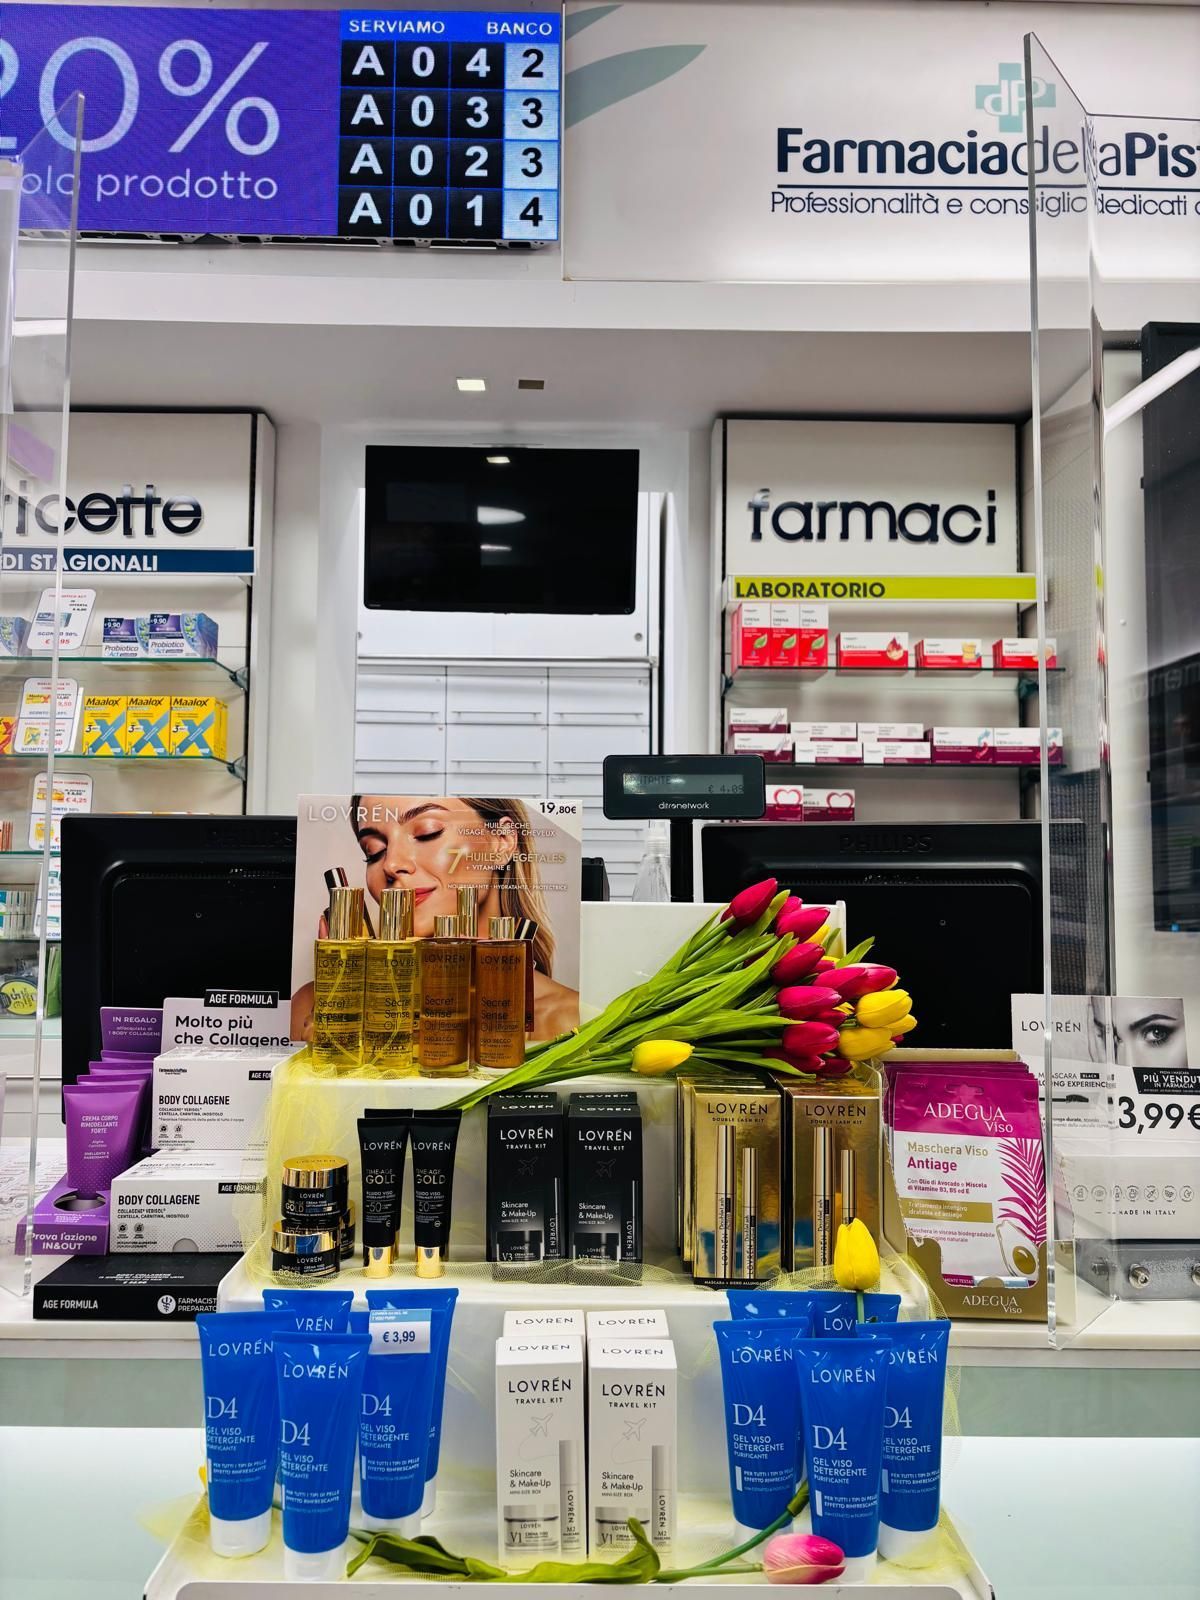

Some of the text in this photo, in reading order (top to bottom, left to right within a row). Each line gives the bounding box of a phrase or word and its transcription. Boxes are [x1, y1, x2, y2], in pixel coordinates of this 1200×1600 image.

[349, 19, 553, 37] SERVIAMO BANCO
[351, 45, 545, 79] A 0 4 2
[350, 93, 545, 130] A 0 3 3
[777, 126, 1200, 178] FarmaciadelaPis
[350, 143, 545, 179] A 0 2 3
[21, 165, 279, 200] olo prodotto
[349, 191, 544, 227] A 0 1 4
[771, 191, 939, 214] Professionalità
[946, 199, 963, 214] e
[969, 191, 1088, 217] consiglio
[2, 484, 202, 536] icette
[748, 488, 997, 544] farmaci
[0, 554, 158, 571] DI STAGIONALI
[735, 582, 886, 598] LABORATORIO
[86, 698, 121, 707] Maalox
[129, 698, 164, 707] Maalox
[172, 698, 209, 707] Maalox
[539, 802, 577, 816] 19,80€
[658, 801, 710, 809] ditronetwork
[308, 804, 399, 823] LOVRÉN
[447, 848, 465, 874] 7
[465, 852, 502, 863] HUILES
[472, 864, 504, 872] VITAMINE
[209, 993, 274, 1006] AGE FORMULA
[175, 1014, 254, 1031] Molto più
[174, 1032, 204, 1045] che
[1142, 1072, 1160, 1083] PIÙ
[158, 1095, 230, 1106] BODY COLLAGENE
[708, 1101, 769, 1115] LOVRÉN
[805, 1104, 867, 1117] LOVRÉN
[924, 1102, 1008, 1122] ADEGUA
[1118, 1095, 1200, 1135] 3,99€
[500, 1126, 554, 1140] LOVRÉN
[984, 1120, 1014, 1133] Viso
[578, 1128, 632, 1142] LOVRÉN
[364, 1141, 402, 1151] LOVRÉN
[413, 1141, 451, 1151] LOVRÉN
[907, 1142, 989, 1157] Maschera Viso
[907, 1156, 958, 1172] Antiage
[221, 1184, 233, 1192] AGE
[118, 1195, 200, 1206] BODY COLLAGENE
[501, 1201, 529, 1209] Skincare
[508, 1209, 537, 1218] Make-Up
[30, 1231, 98, 1242] Prova l'azione
[42, 1242, 83, 1250] IN&OUT
[42, 1300, 98, 1309] AGE FORMULA
[962, 1295, 1019, 1307] ADEGUA
[1003, 1305, 1023, 1314] Viso
[383, 1330, 416, 1345] € 3,99
[209, 1338, 274, 1357] LOVRÉN
[731, 1346, 793, 1364] LOVRÉN
[283, 1362, 349, 1379] LOVRÉN
[811, 1367, 876, 1383] LOVRÉN
[508, 1377, 572, 1393] LOVRÉN
[602, 1382, 665, 1397] LOVRÉN
[207, 1396, 238, 1420] D4
[360, 1393, 392, 1417] D4
[732, 1403, 767, 1428] D4
[281, 1418, 312, 1447] D4
[733, 1433, 772, 1444] GEL VISO
[812, 1424, 848, 1451] D4
[733, 1442, 785, 1453] DETERGENTE
[813, 1457, 853, 1468] GEL VISO
[510, 1469, 542, 1478] Skincare
[813, 1465, 868, 1477] DETERGENTE
[510, 1479, 552, 1490] & Make-Up
[813, 1475, 850, 1485] PURIFICANTE
